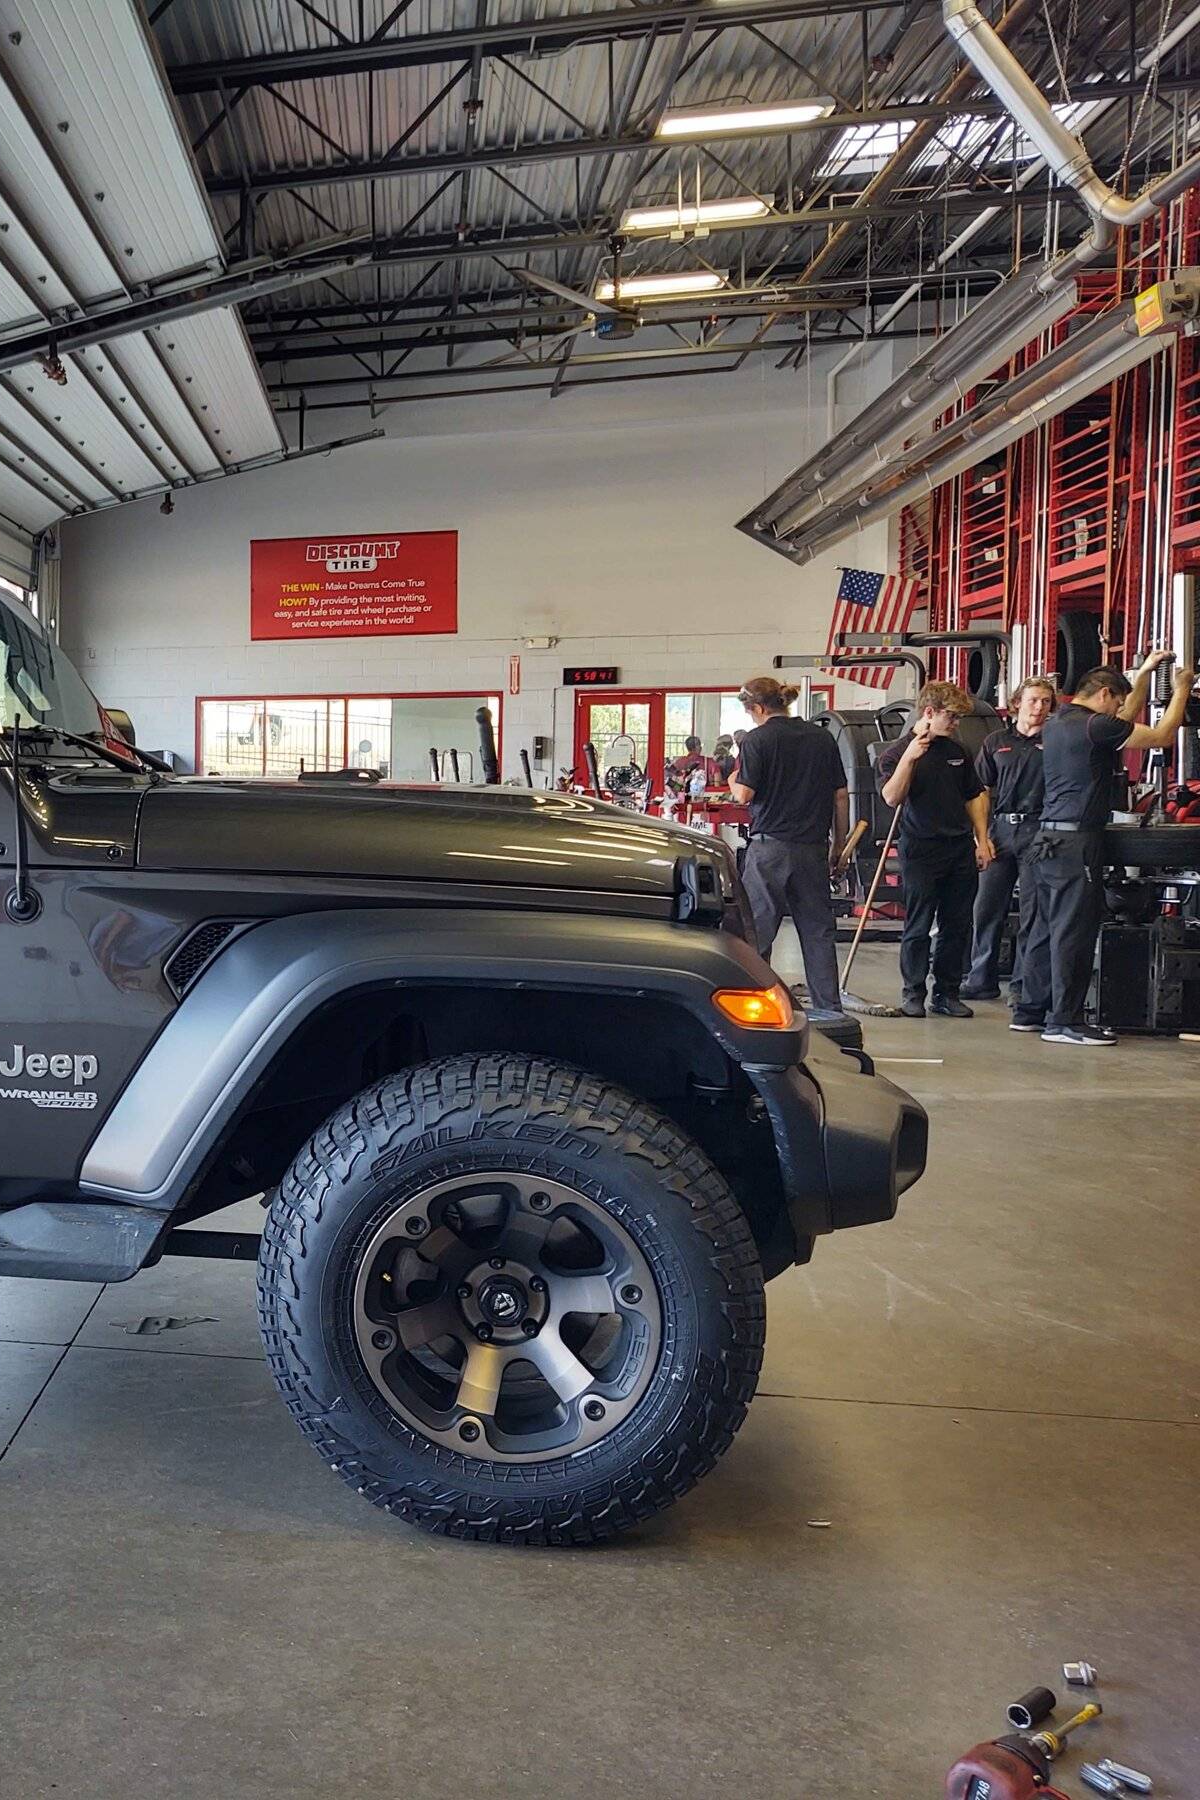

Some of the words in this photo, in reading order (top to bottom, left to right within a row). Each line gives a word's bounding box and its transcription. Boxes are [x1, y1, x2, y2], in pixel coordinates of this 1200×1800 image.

[306, 541, 400, 562] DISCOUNT
[332, 560, 371, 570] TIRE
[281, 584, 300, 593] THE
[301, 583, 320, 592] WIN
[325, 582, 348, 591] Make
[349, 582, 380, 590] Dreams
[381, 580, 406, 589] Come
[407, 579, 426, 588] True
[279, 598, 307, 607] HOW?
[308, 597, 319, 607] By
[320, 596, 358, 607] providing
[359, 594, 373, 604] the
[374, 595, 395, 603] most
[274, 610, 293, 620] easy,
[294, 608, 310, 617] and
[311, 608, 328, 617] safe
[329, 607, 342, 616] tire
[343, 606, 360, 615] and
[360, 605, 385, 614] wheel
[385, 604, 422, 616] purchase
[291, 620, 319, 628] service
[320, 617, 364, 628] experience
[365, 617, 373, 625] in
[374, 616, 388, 625] the
[388, 615, 415, 624] world!
[36, 1100, 95, 1108] SPORT
